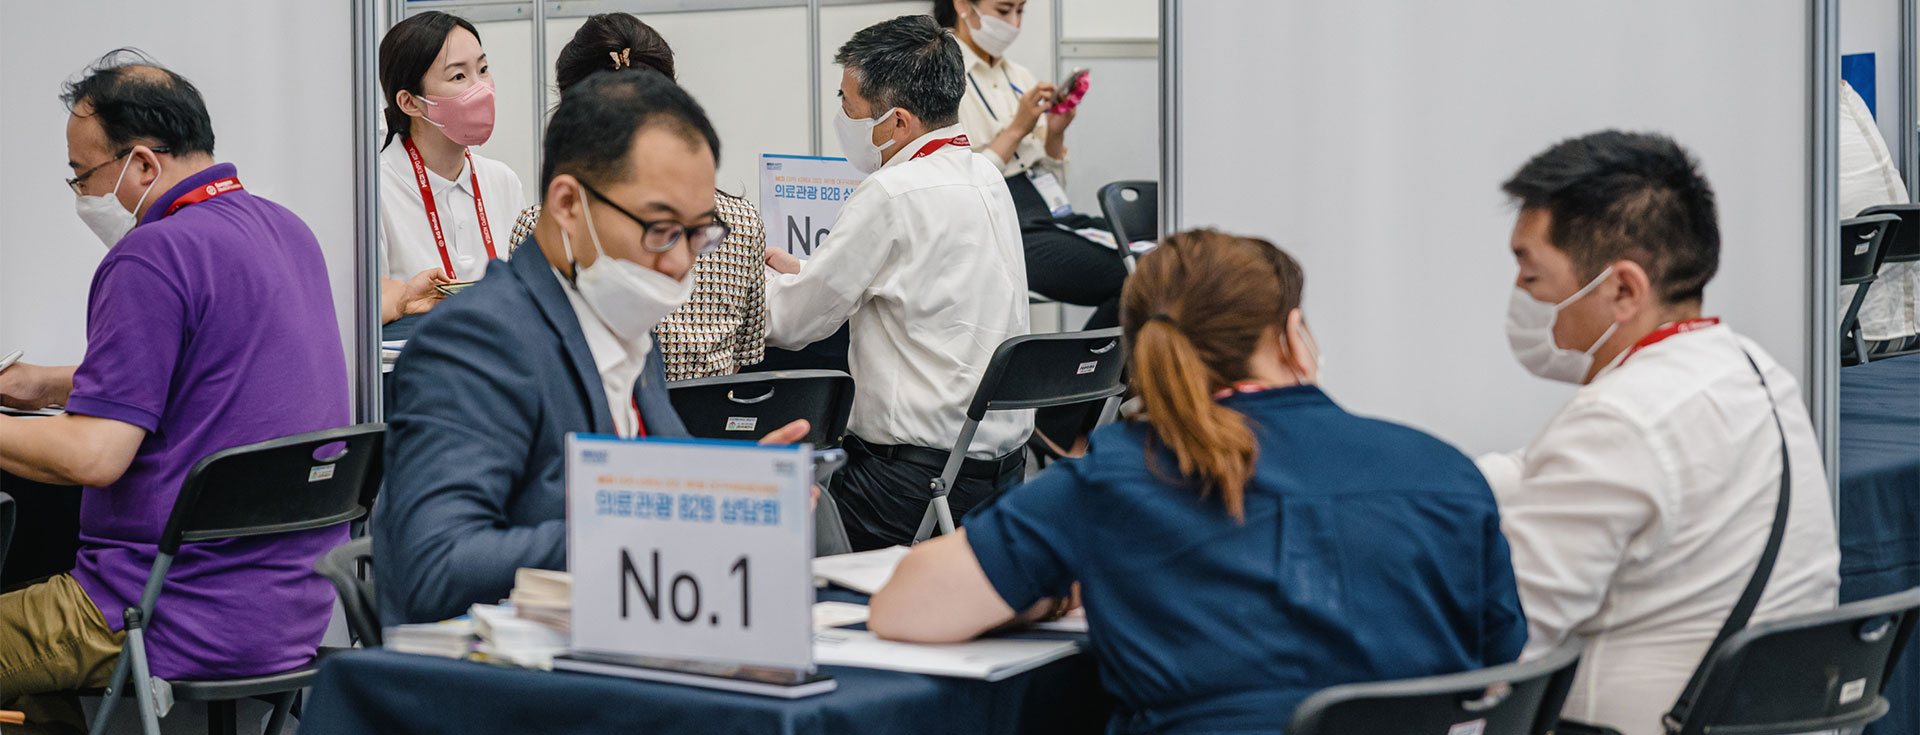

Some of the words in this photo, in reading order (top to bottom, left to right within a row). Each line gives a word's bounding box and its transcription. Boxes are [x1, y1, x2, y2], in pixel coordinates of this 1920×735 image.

[775, 184, 818, 200] 의료관광
[820, 187, 840, 201] B2B
[595, 489, 674, 519] 의료관광
[678, 493, 716, 522] B2B
[721, 497, 780, 526] 상담회
[620, 549, 750, 627] No.1
